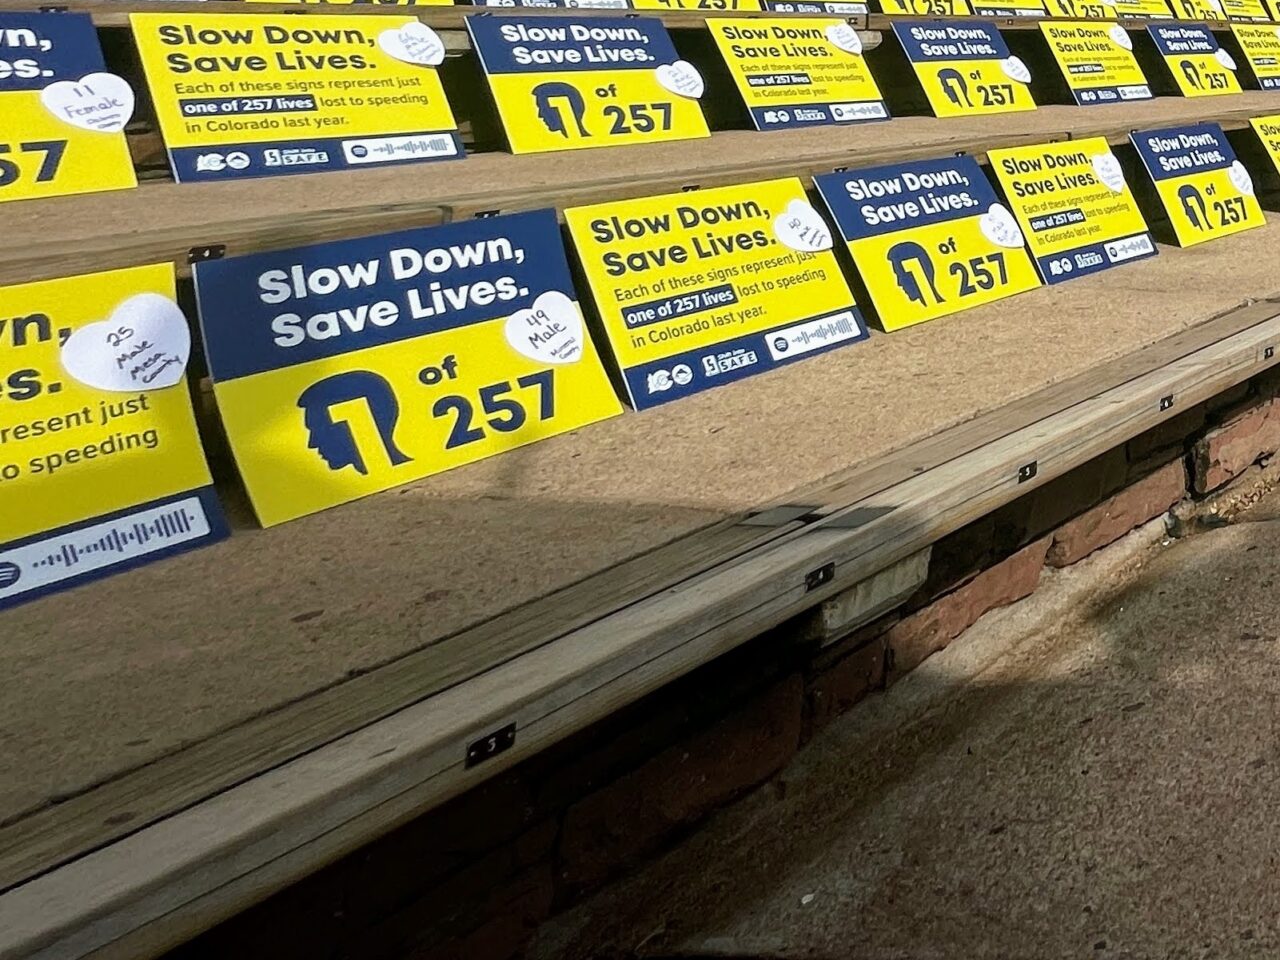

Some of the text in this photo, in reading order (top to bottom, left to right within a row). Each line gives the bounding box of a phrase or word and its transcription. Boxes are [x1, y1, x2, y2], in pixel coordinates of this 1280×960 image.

[922, 0, 953, 15] 257
[159, 25, 254, 46] Slow
[263, 25, 375, 47] Down,
[501, 24, 649, 44] Slow Down,
[722, 26, 768, 40] Slow
[772, 26, 829, 41] Down,
[911, 27, 991, 41] Slow Down,
[512, 46, 655, 64] Save Lives.
[731, 43, 833, 58] Save Lives.
[920, 42, 996, 56] Save Lives.
[167, 50, 376, 74] Save Lives.
[175, 76, 421, 95] Each of these signs represent just
[970, 70, 982, 80] of
[74, 85, 95, 97] 11
[595, 84, 617, 98] of
[977, 85, 1014, 106] 257
[64, 97, 124, 119] Female
[184, 93, 429, 114] one of 257 lives lost to speeding
[186, 116, 350, 134] in Colorado last year.
[603, 103, 672, 134] 257
[1148, 132, 1219, 153] Slow Down,
[1002, 157, 1042, 175] Slow
[1043, 152, 1093, 169] Down,
[1159, 150, 1226, 172] Save Lives.
[845, 168, 970, 201] Slow Down,
[1012, 172, 1100, 197] Save Lives.
[1205, 183, 1216, 195] of
[860, 190, 979, 225] Save Lives.
[1213, 196, 1248, 227] 257
[590, 200, 771, 243] Slow Down,
[602, 245, 688, 277] Save
[693, 229, 777, 258] Lives.
[938, 237, 957, 255] of
[258, 237, 525, 304] Slow Down,
[614, 283, 648, 303] Each
[652, 278, 665, 292] of
[668, 269, 705, 290] these
[707, 264, 740, 281] signs
[741, 254, 795, 275] represent
[950, 252, 1009, 297] 257
[626, 268, 826, 325] one of 257 lives lost to speeding
[271, 276, 529, 348] Save Lives.
[526, 309, 550, 327] 49
[0, 311, 72, 348] n,
[106, 326, 134, 347] 25
[528, 322, 567, 349] Male
[631, 303, 768, 348] in Colorado last year.
[116, 341, 153, 369] Male
[720, 354, 756, 371] SAFE
[419, 355, 459, 385] of
[0, 369, 62, 401] s.
[100, 394, 150, 424] just
[432, 369, 554, 449] 257
[0, 429, 158, 483] o speeding
